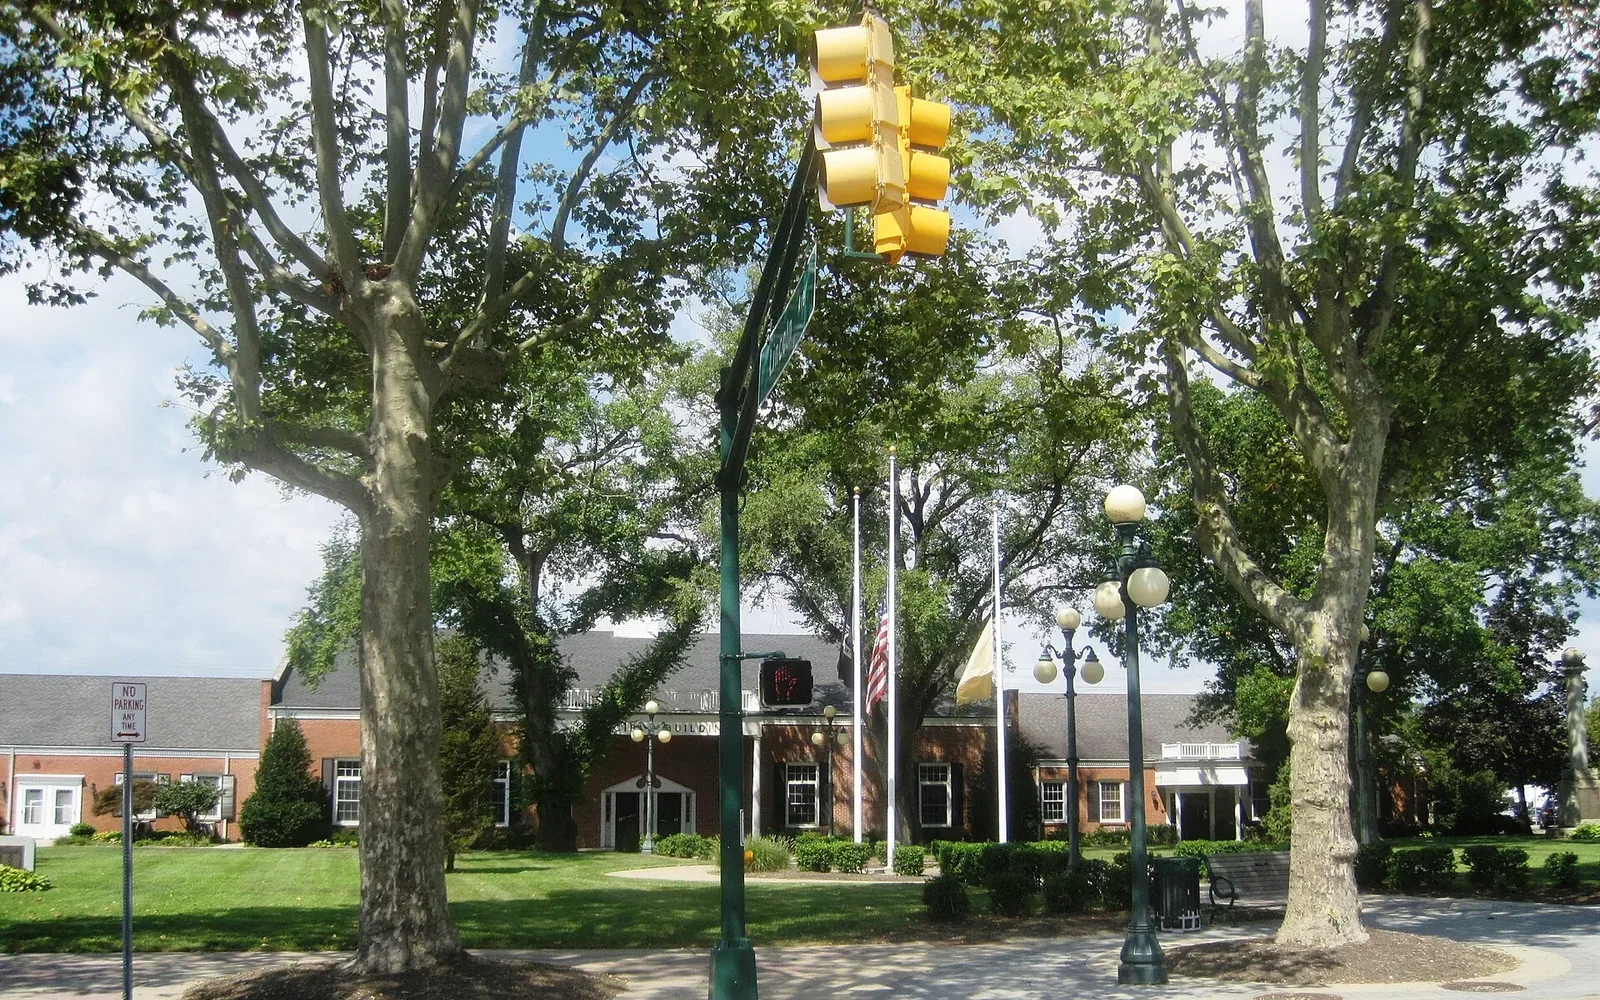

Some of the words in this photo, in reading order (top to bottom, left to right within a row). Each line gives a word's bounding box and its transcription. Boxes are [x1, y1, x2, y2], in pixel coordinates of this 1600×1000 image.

[769, 319, 793, 377] Lincoln
[122, 686, 136, 697] NO
[114, 699, 144, 710] PARKING
[122, 713, 136, 721] ANY
[122, 722, 136, 730] TIME
[665, 723, 720, 733] BUILDIN
